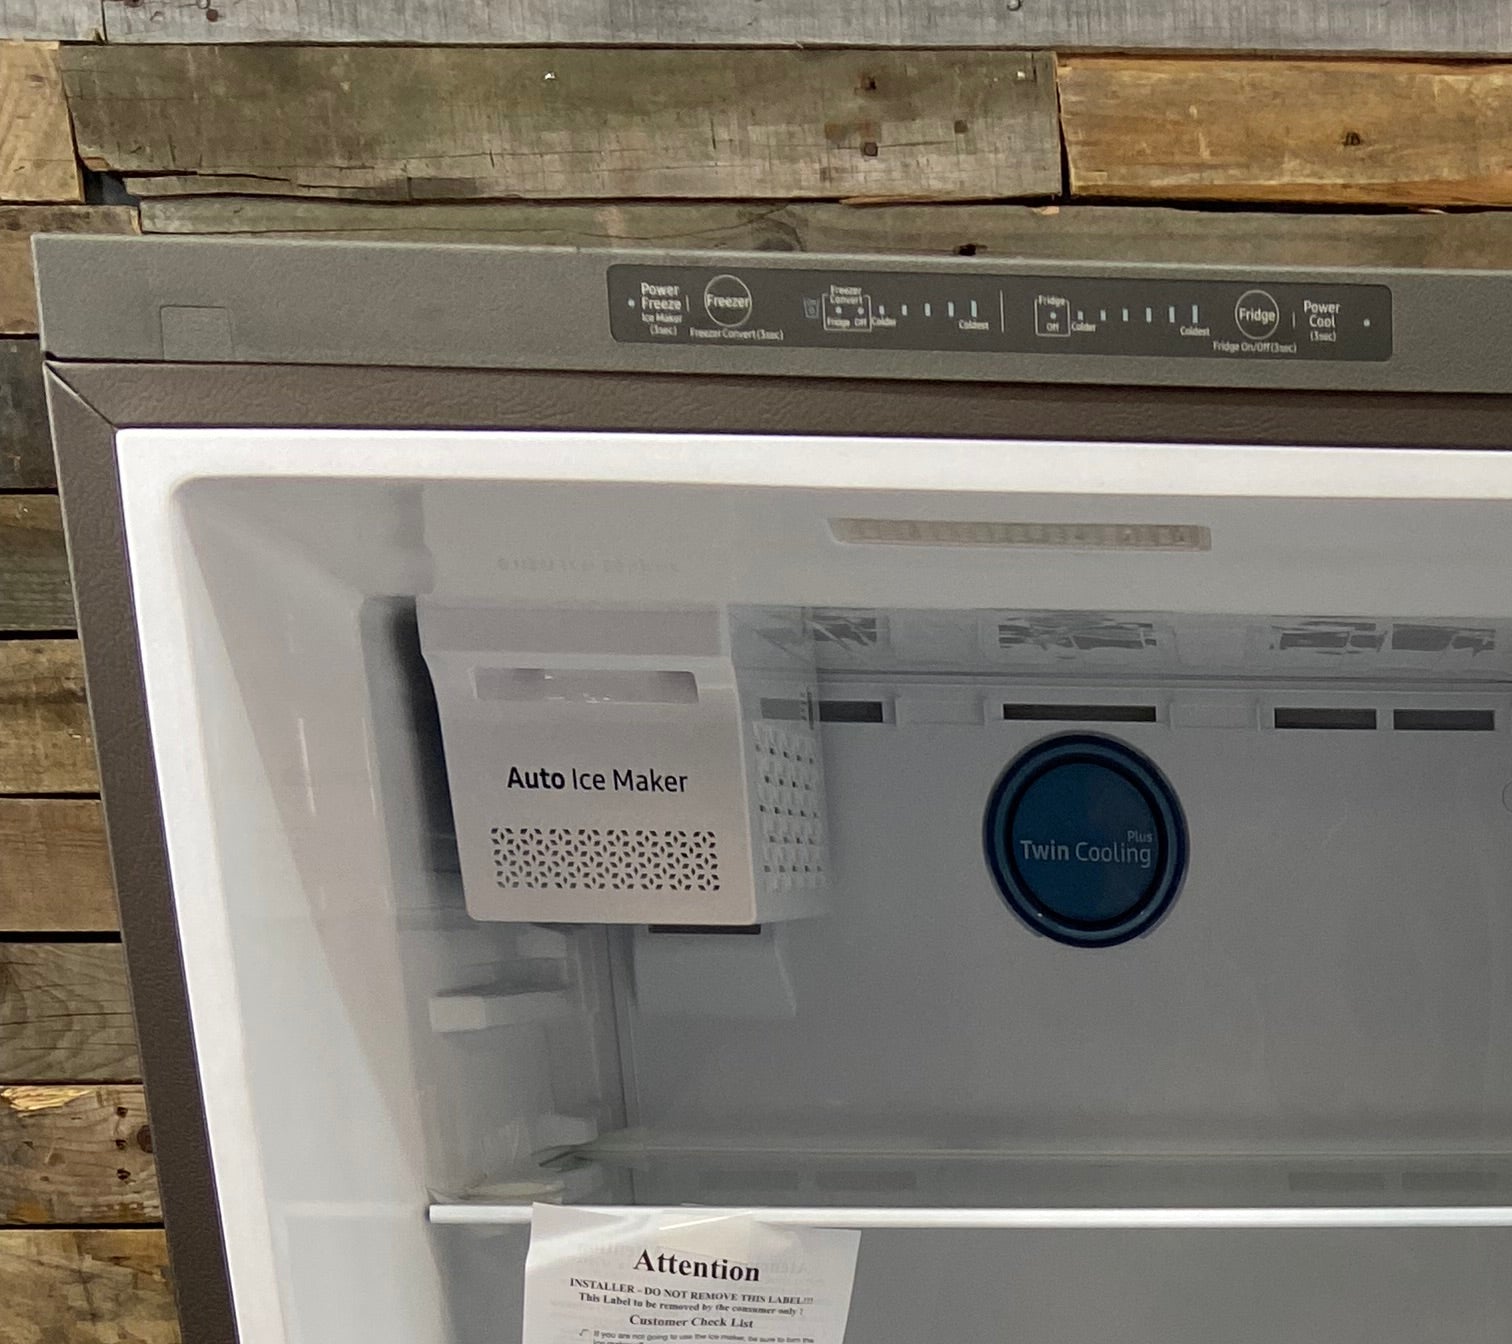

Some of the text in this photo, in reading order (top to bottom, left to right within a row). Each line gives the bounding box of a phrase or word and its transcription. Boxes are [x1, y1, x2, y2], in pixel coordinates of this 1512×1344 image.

[640, 282, 680, 296] Power
[830, 285, 862, 295] Freezer
[641, 296, 681, 310] Freeze
[707, 293, 750, 309] Freezer
[1038, 295, 1066, 307] Fridge
[1303, 299, 1340, 314] Power
[642, 313, 682, 323] Ice Maker
[1239, 308, 1276, 325] Fridge
[1309, 314, 1336, 328] Cool
[690, 327, 721, 338] Freezer
[722, 328, 756, 339] Convert
[1180, 326, 1211, 336] Coldest
[1213, 340, 1240, 353] Fridge
[507, 767, 688, 792] Auto Ice Maker
[1127, 830, 1153, 843] Plus
[1020, 840, 1151, 868] Twin Cooling
[633, 1249, 759, 1281] Attention
[570, 1278, 635, 1293] INSTALLER
[644, 1287, 661, 1296] DO
[664, 1289, 688, 1299] NOT
[691, 1292, 738, 1301] REMOVE
[742, 1294, 765, 1303] THIS
[579, 1292, 600, 1303] This
[604, 1295, 631, 1306] Label
[634, 1299, 643, 1307] to
[646, 1300, 657, 1308] be
[660, 1303, 700, 1311] removed
[702, 1304, 712, 1312] by
[732, 1306, 776, 1314] consumer
[630, 1314, 754, 1328] Customer Check List
